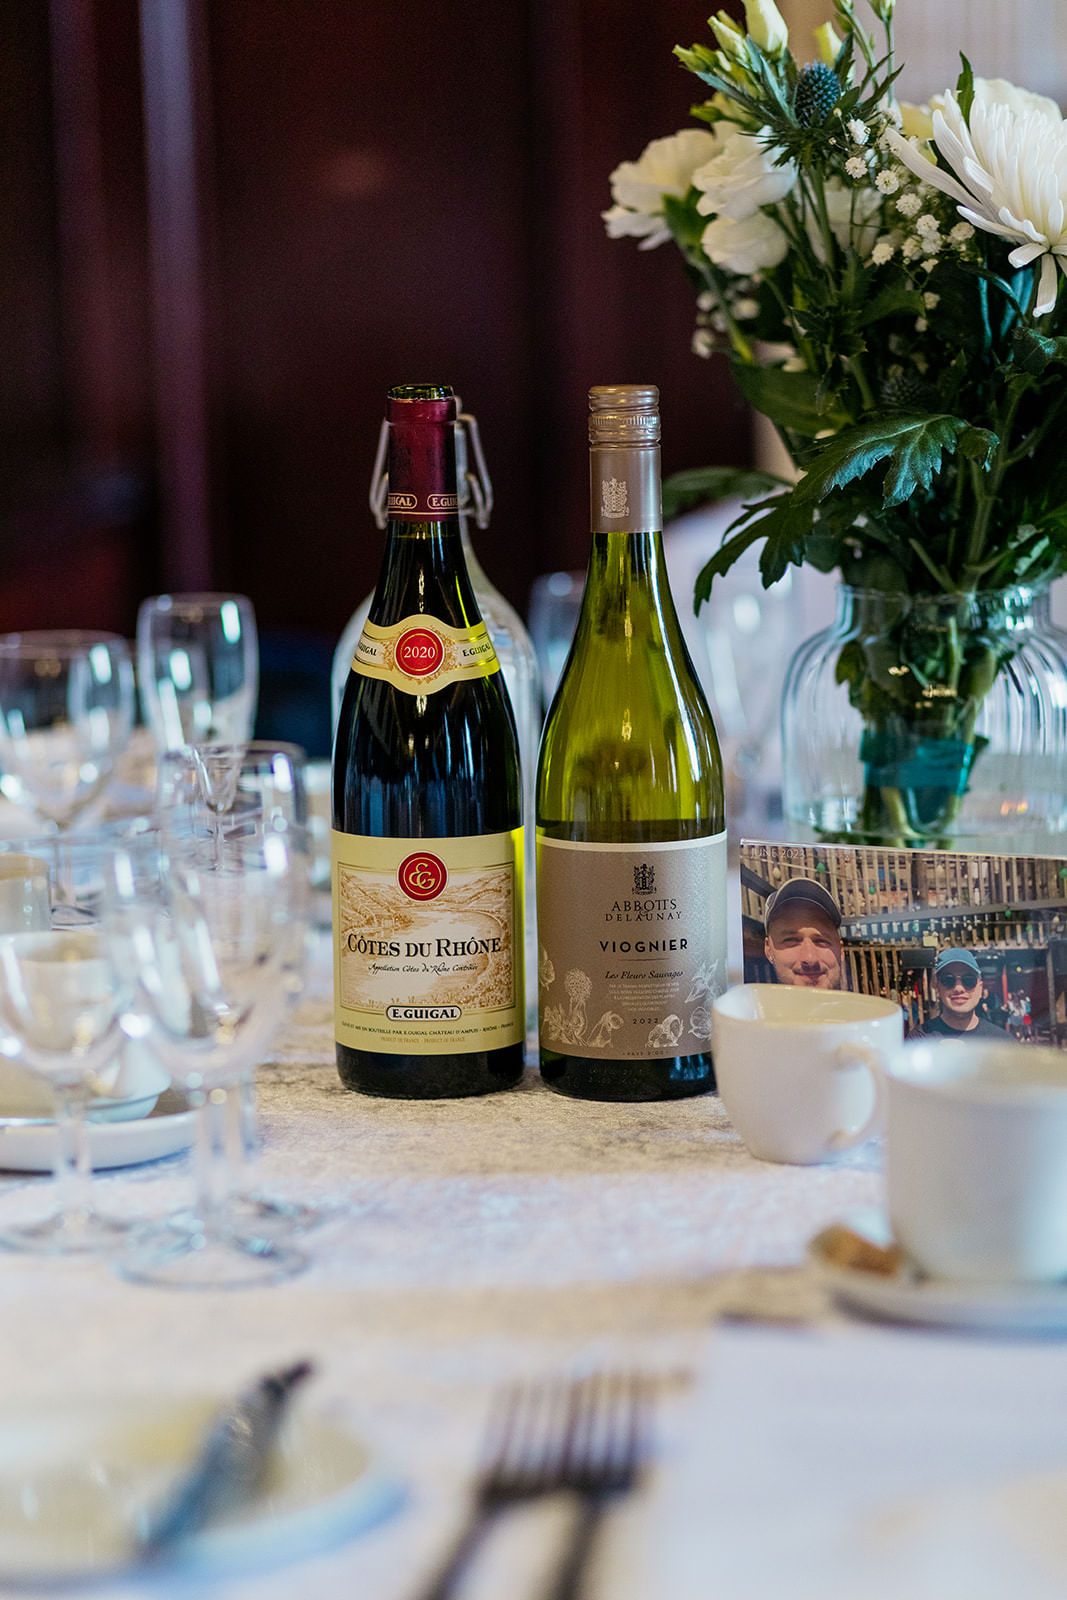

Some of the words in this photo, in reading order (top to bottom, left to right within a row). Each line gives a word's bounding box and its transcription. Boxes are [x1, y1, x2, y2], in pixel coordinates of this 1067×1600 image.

[404, 646, 436, 659] 2020
[751, 847, 777, 858] JUNE
[611, 899, 677, 912] ABBOTTS
[605, 911, 682, 922] DELAUNAY
[347, 933, 400, 957] CÔTES
[405, 943, 432, 957] DU
[435, 936, 502, 957] RHÔNE
[599, 938, 688, 953] VIOGNIER
[605, 970, 619, 979] Les
[620, 970, 646, 980] Fleurs
[632, 1017, 659, 1025] 2022
